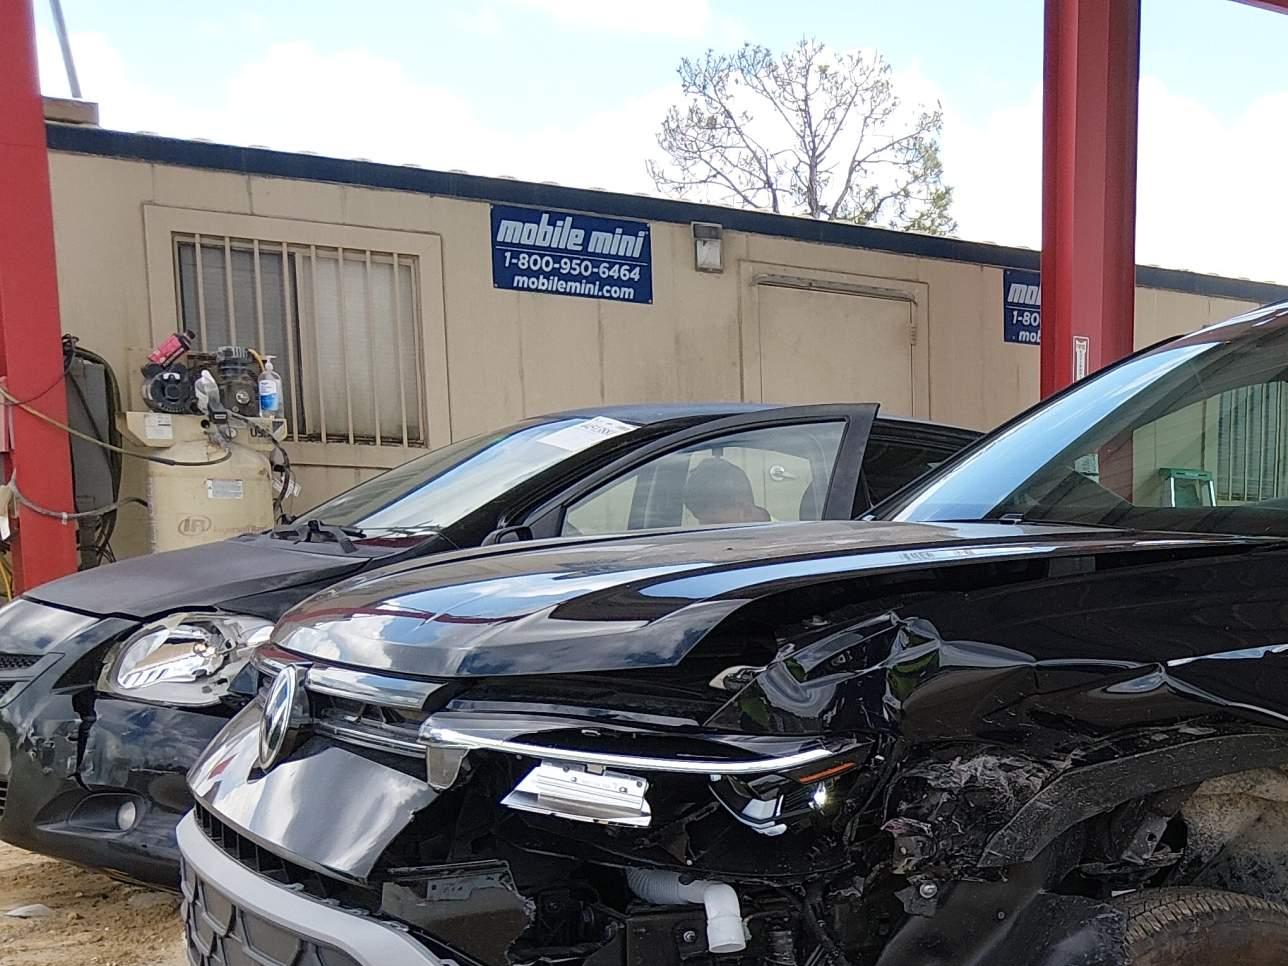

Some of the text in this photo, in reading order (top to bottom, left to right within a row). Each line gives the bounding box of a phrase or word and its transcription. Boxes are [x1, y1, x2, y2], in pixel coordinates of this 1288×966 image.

[497, 213, 645, 258] mobile mini
[504, 252, 641, 281] 1-800-950-6464
[513, 275, 635, 299] mobilemini.com
